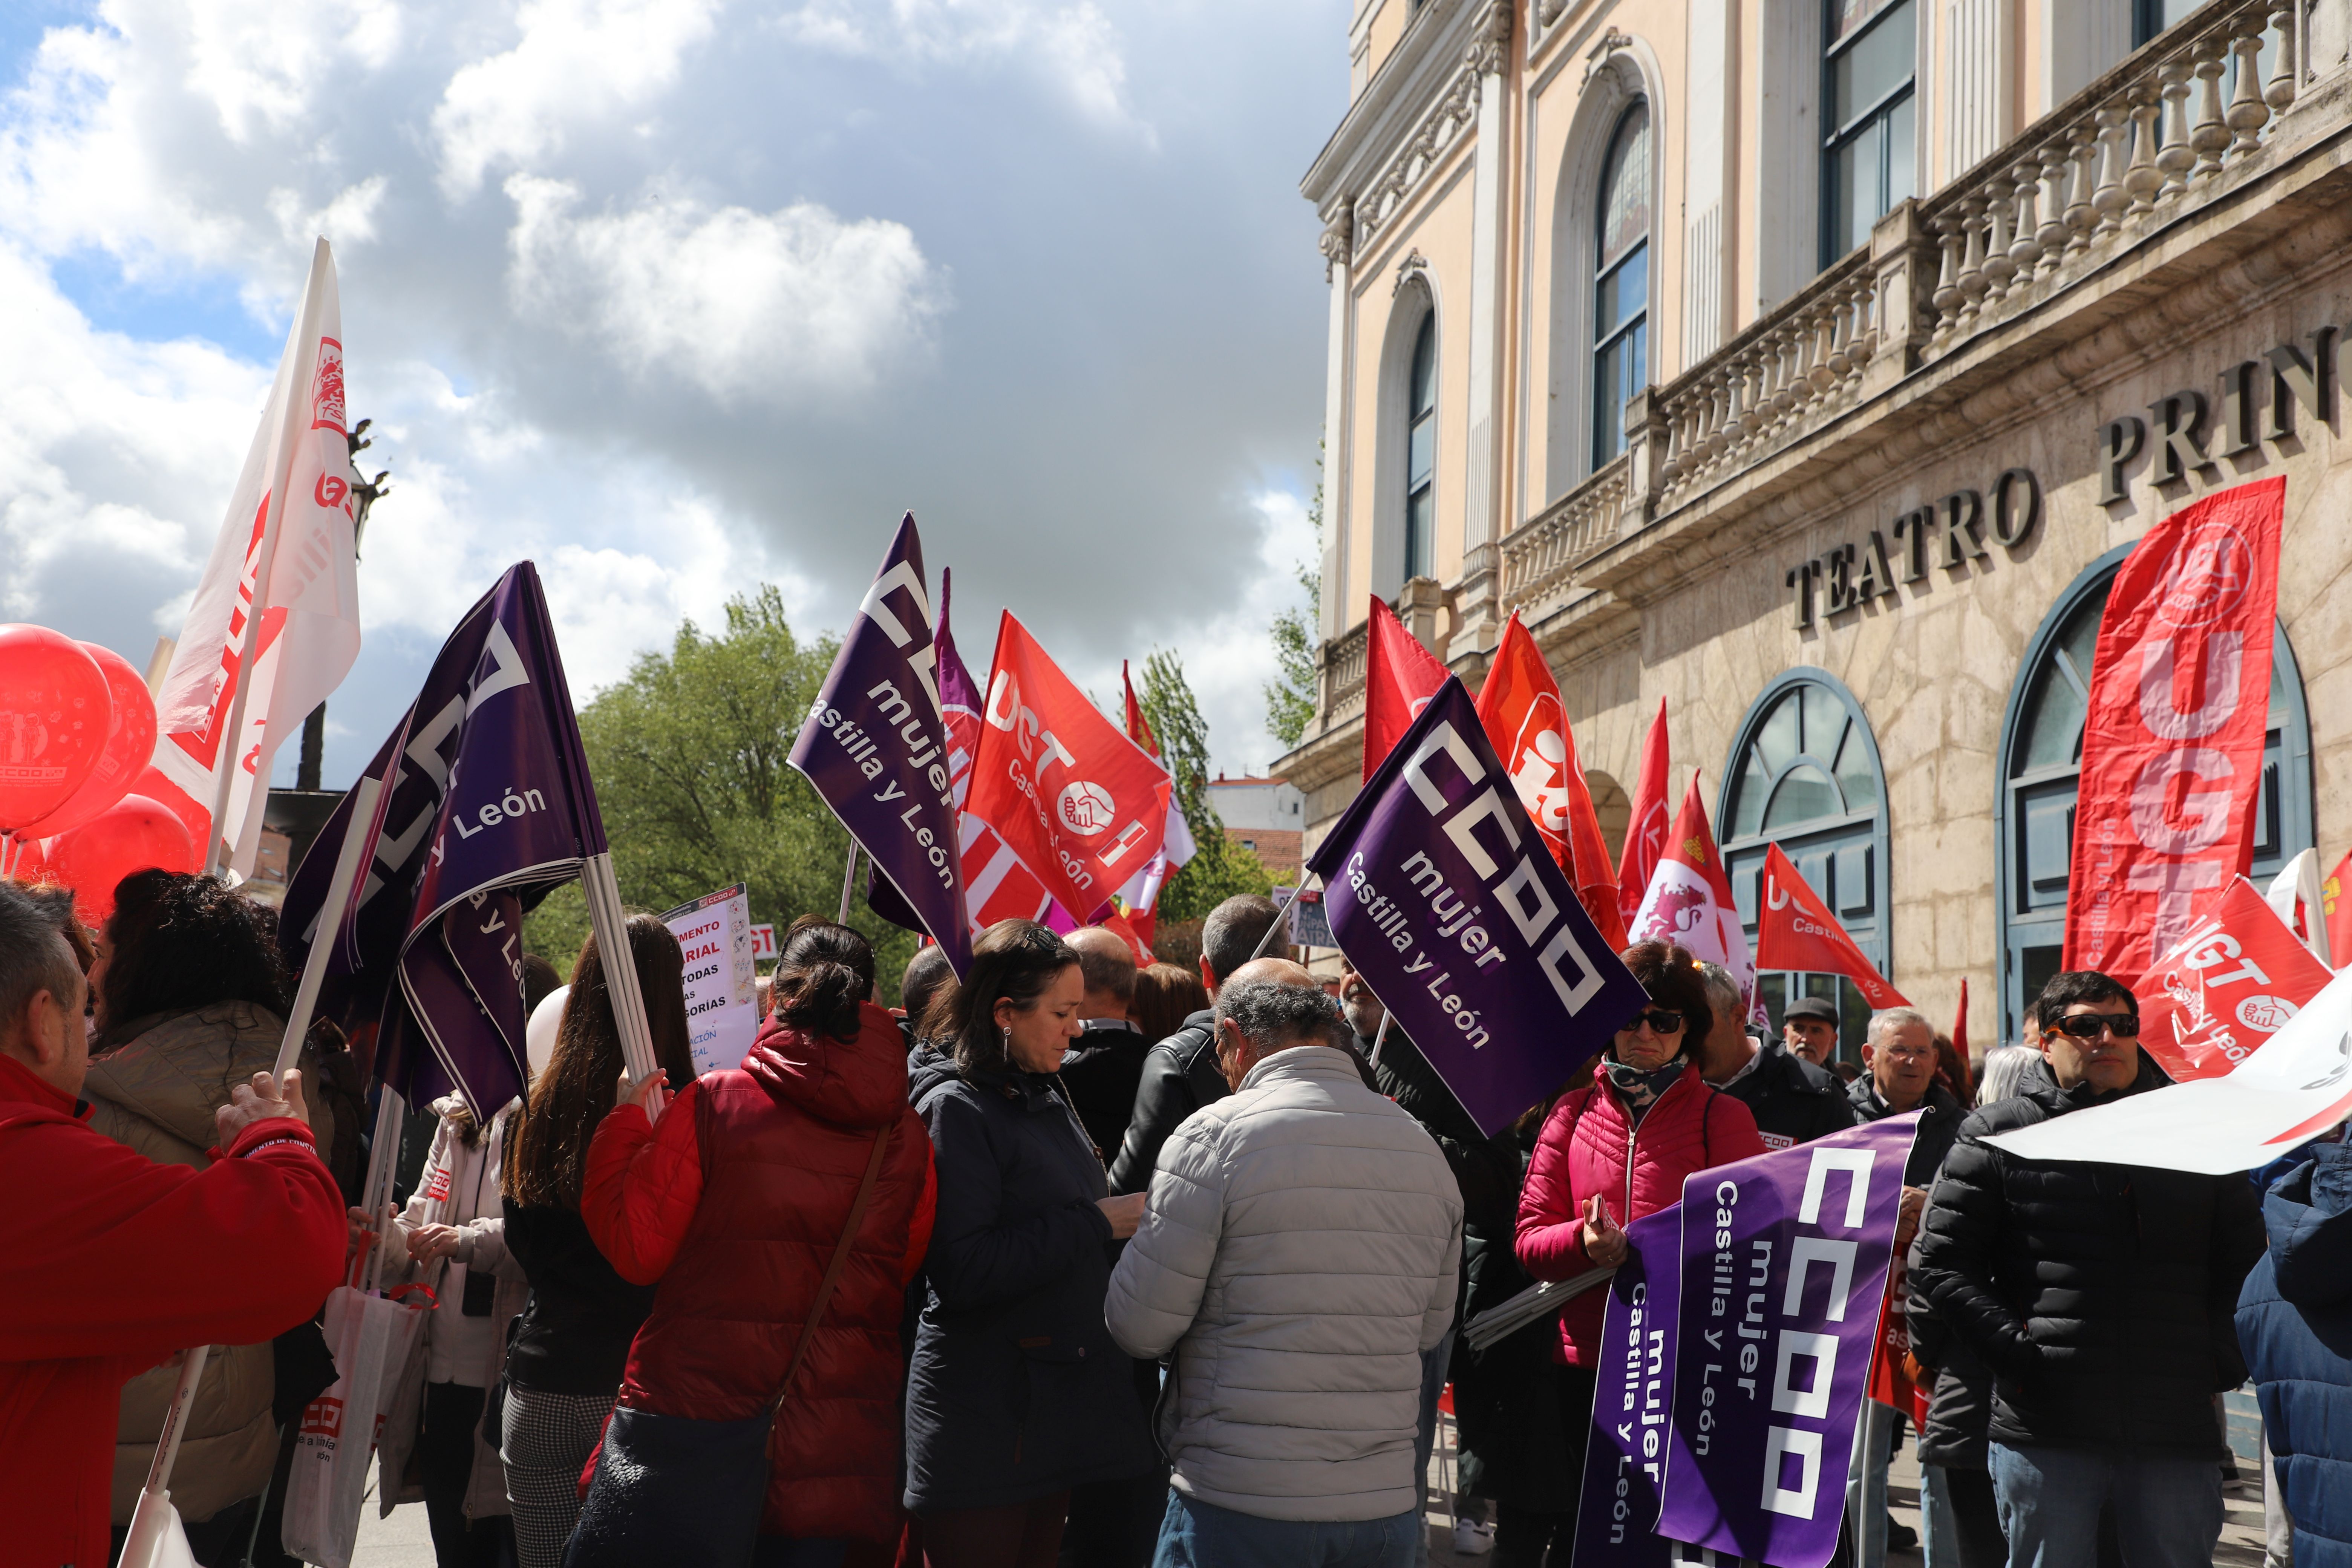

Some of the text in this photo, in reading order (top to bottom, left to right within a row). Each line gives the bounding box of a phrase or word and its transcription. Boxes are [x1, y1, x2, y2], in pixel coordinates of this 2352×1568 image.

[1786, 467, 2040, 629] TEATRO
[809, 691, 954, 889] astilla y León
[867, 679, 954, 808] mujer
[986, 669, 1076, 787] UGT
[2127, 630, 2243, 967] UGT
[430, 787, 547, 867] y León
[708, 892, 728, 904] CCOO
[1402, 720, 1606, 1017] CCOO
[2086, 818, 2117, 968] Castilla y León
[479, 908, 506, 934] y
[675, 921, 720, 943] MENTO
[683, 942, 720, 964] RIAL
[1346, 851, 1490, 1050] Castilla y León
[1400, 850, 1507, 969] mujer
[1696, 1181, 1739, 1456] Castilla y León
[1737, 1240, 1772, 1400] mujer
[1760, 1147, 1877, 1521] CCOO
[1610, 1282, 1646, 1544] Castilla y León
[1641, 1329, 1665, 1483] mujer
